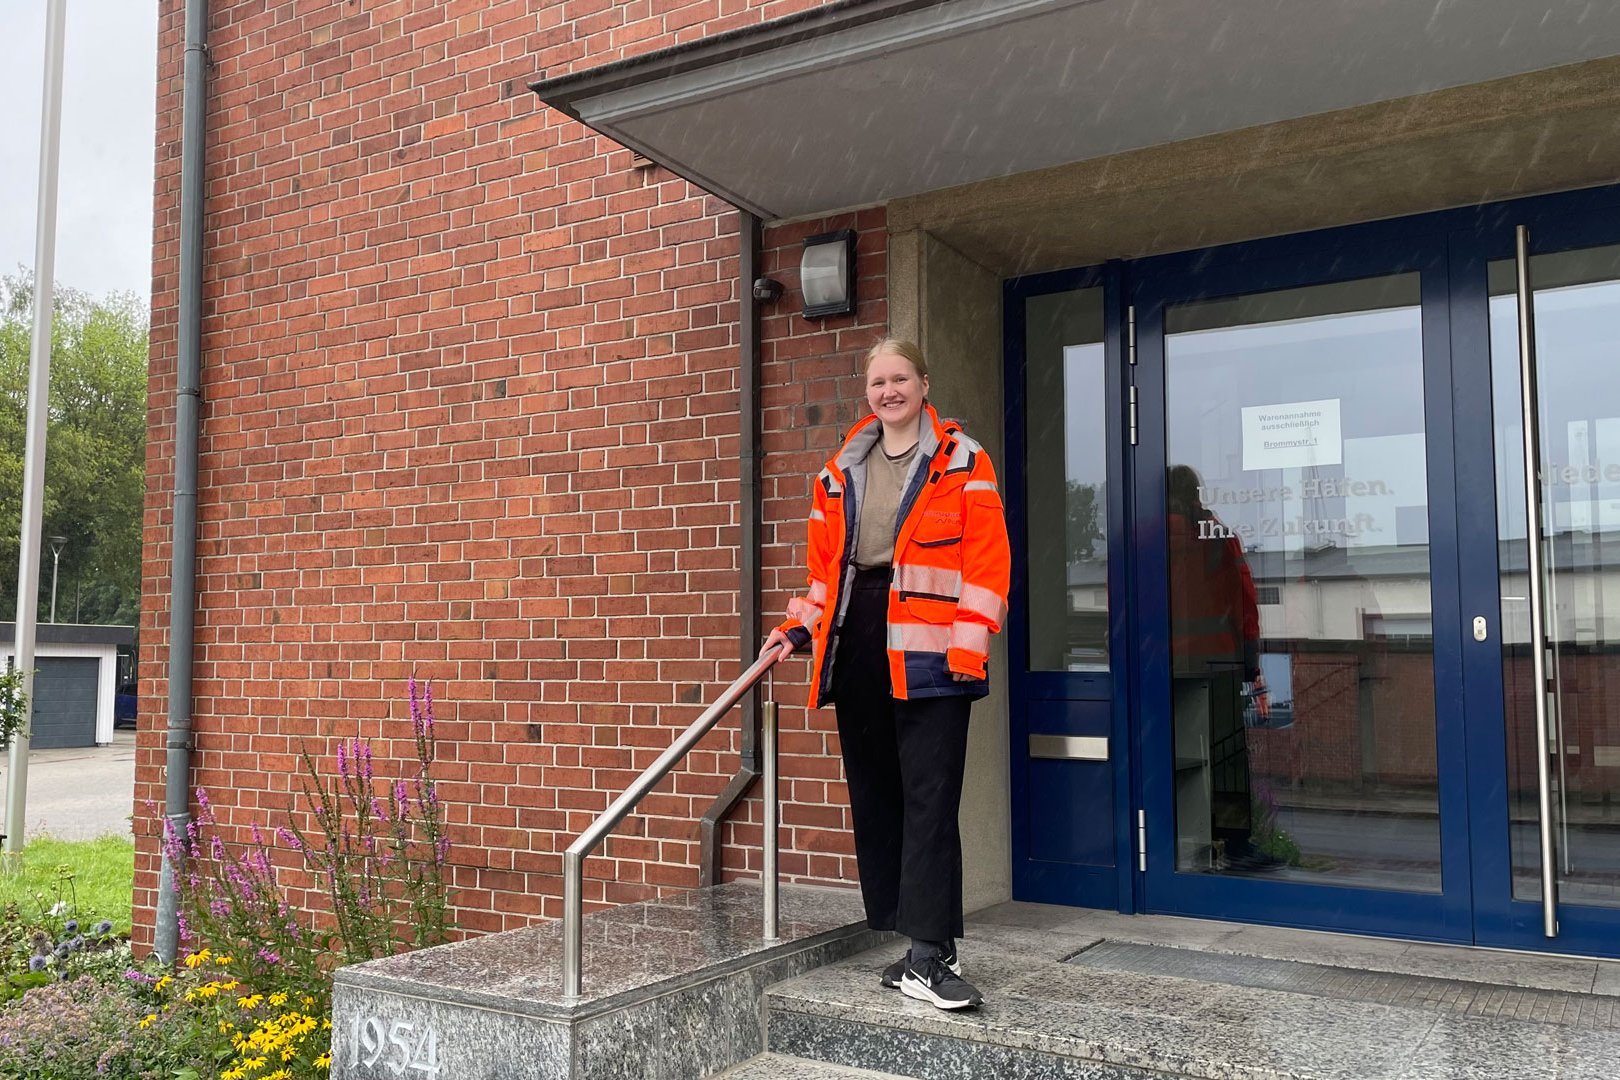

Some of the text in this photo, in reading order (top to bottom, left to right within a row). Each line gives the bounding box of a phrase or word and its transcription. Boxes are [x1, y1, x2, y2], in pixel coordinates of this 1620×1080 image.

[1258, 411, 1321, 422] Warenannahme
[1261, 420, 1320, 431] ausschließlich
[1263, 439, 1312, 449] Brommystr.
[1196, 477, 1395, 505] Unsere Häfen.
[1197, 512, 1384, 540] Ihre Zukunft.
[348, 1005, 442, 1080] 1954
